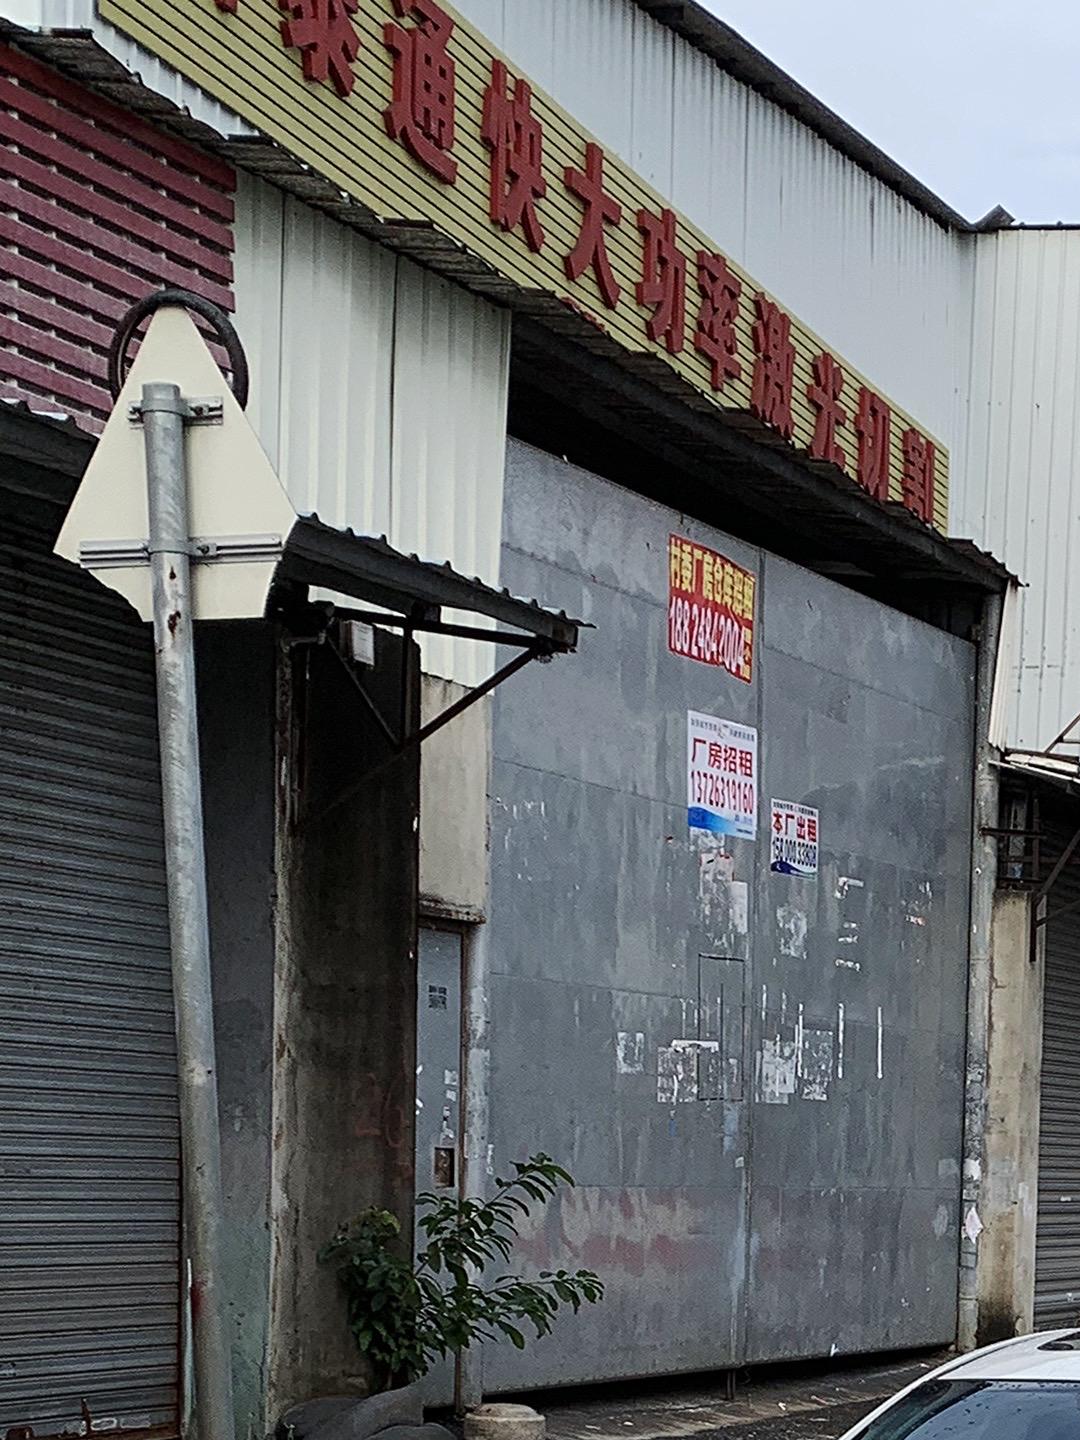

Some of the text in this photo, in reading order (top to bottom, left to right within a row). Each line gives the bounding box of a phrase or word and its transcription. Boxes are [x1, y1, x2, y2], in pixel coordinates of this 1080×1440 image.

[214, 0, 935, 524] 泰通快大功率激光切割
[692, 738, 753, 777] 厂房招租
[773, 811, 817, 842] 本厂出租
